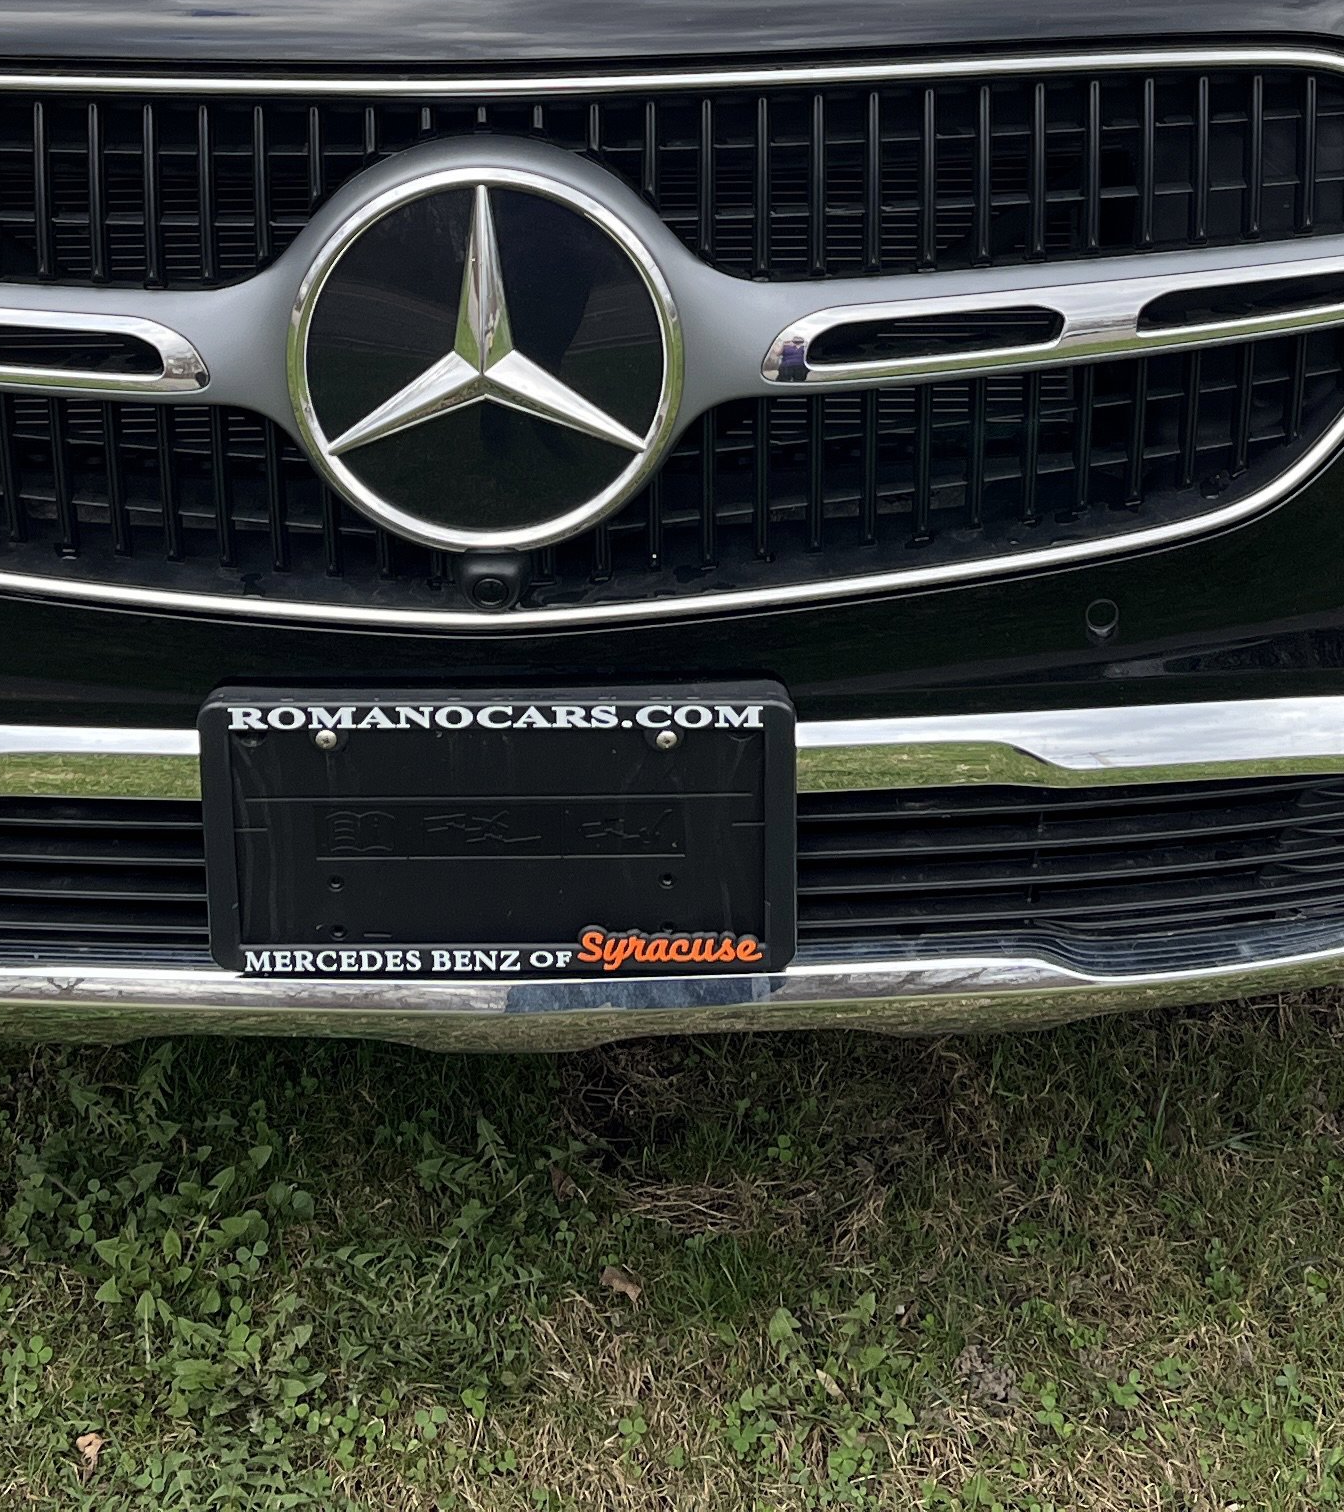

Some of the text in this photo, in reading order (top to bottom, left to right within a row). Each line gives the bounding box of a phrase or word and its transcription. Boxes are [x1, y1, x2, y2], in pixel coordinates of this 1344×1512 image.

[228, 705, 764, 729] ROMANOCARS.COM
[244, 930, 764, 972] MERCEDES BENZ OF Syracuse
